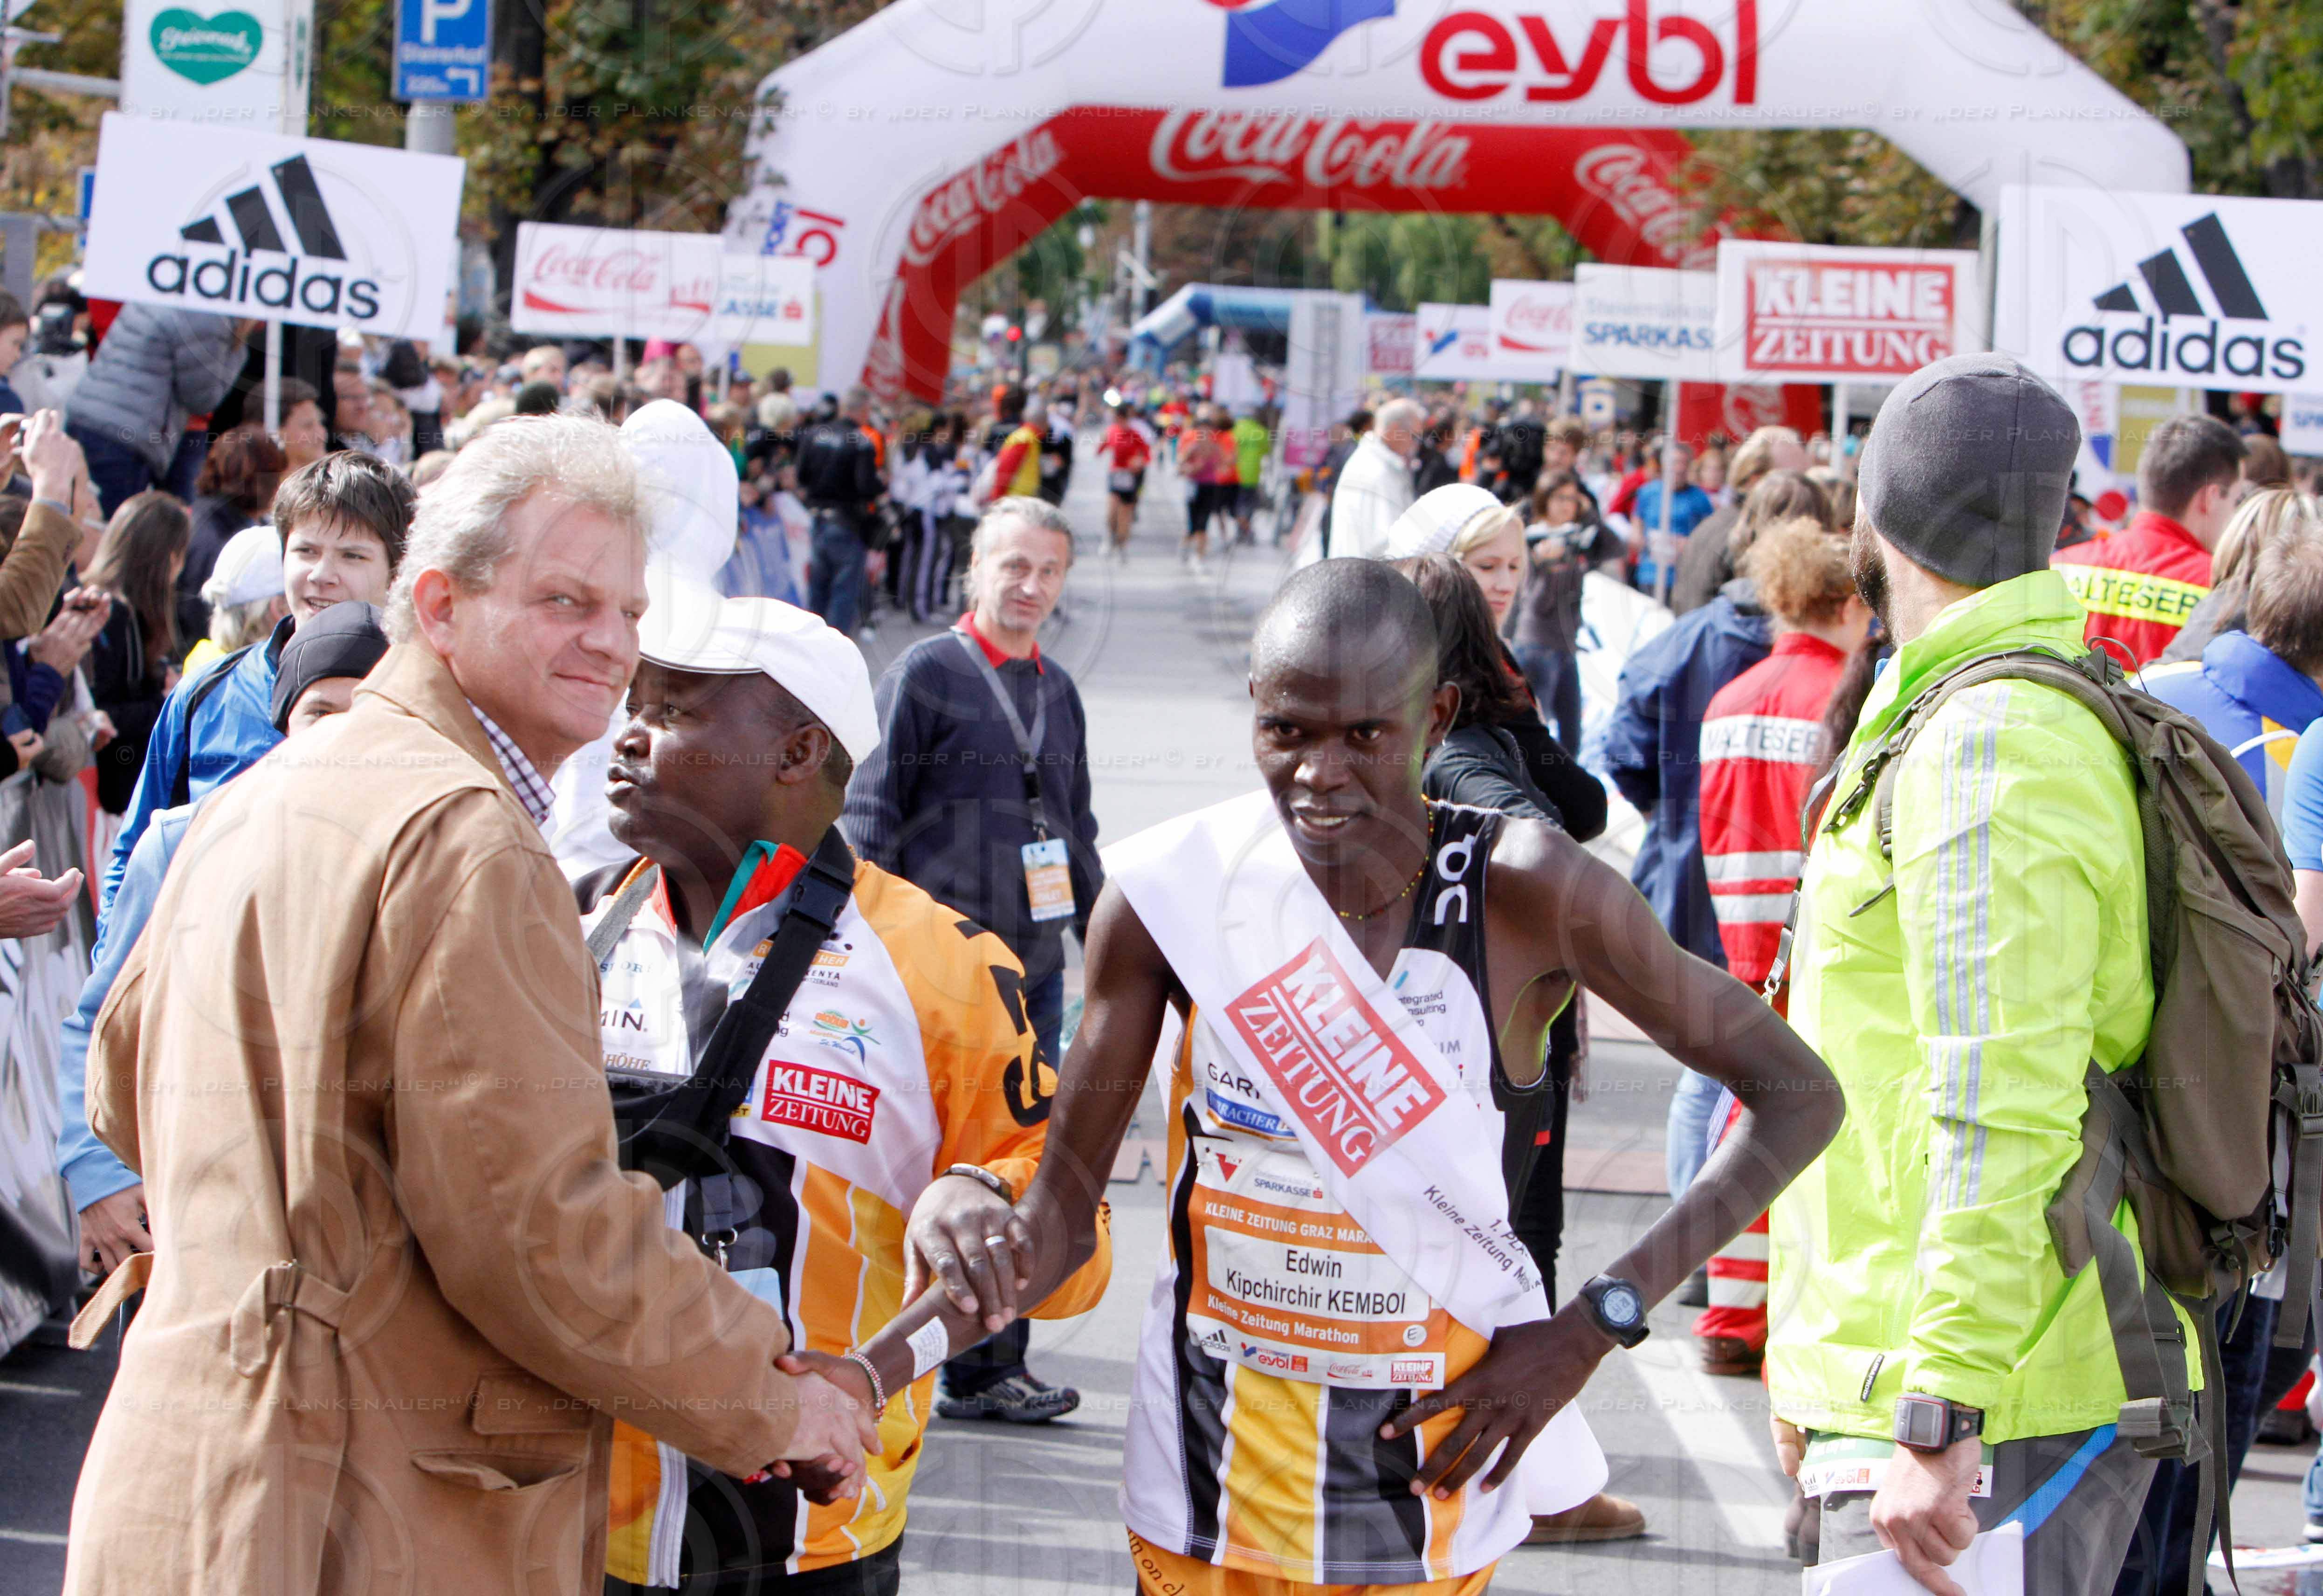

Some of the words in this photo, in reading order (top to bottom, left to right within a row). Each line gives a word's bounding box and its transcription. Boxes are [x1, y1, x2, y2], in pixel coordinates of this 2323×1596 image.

[1419, 0, 1758, 105] eybl
[147, 248, 379, 319] adidas
[1755, 268, 1948, 321] KLEINE
[1753, 327, 1946, 367] ZEITUNG
[2063, 316, 2305, 378] adidas
[1281, 953, 1432, 1130] KLEINE
[772, 1066, 872, 1113] KLEINE
[1239, 991, 1377, 1163] ZEITUNG
[768, 1098, 869, 1137] ZEITUNG
[1254, 1178, 1311, 1198] SPARKASSE
[1205, 1201, 1244, 1222] KLEINE
[1247, 1211, 1297, 1234] ZEITUNG
[1300, 1224, 1333, 1239] GRAZ
[1423, 1184, 1465, 1225] Kleine
[1463, 1225, 1513, 1272] Zeitung
[1286, 1249, 1342, 1279] Edwin
[1226, 1268, 1322, 1309] Kipchirchir
[1327, 1289, 1406, 1314] KEMBOI
[1208, 1294, 1238, 1320] Kleine
[1240, 1310, 1289, 1337] Zeitung
[1293, 1321, 1359, 1344] Marathon
[1258, 1354, 1289, 1370] eybl
[1142, 1559, 1162, 1580] on
